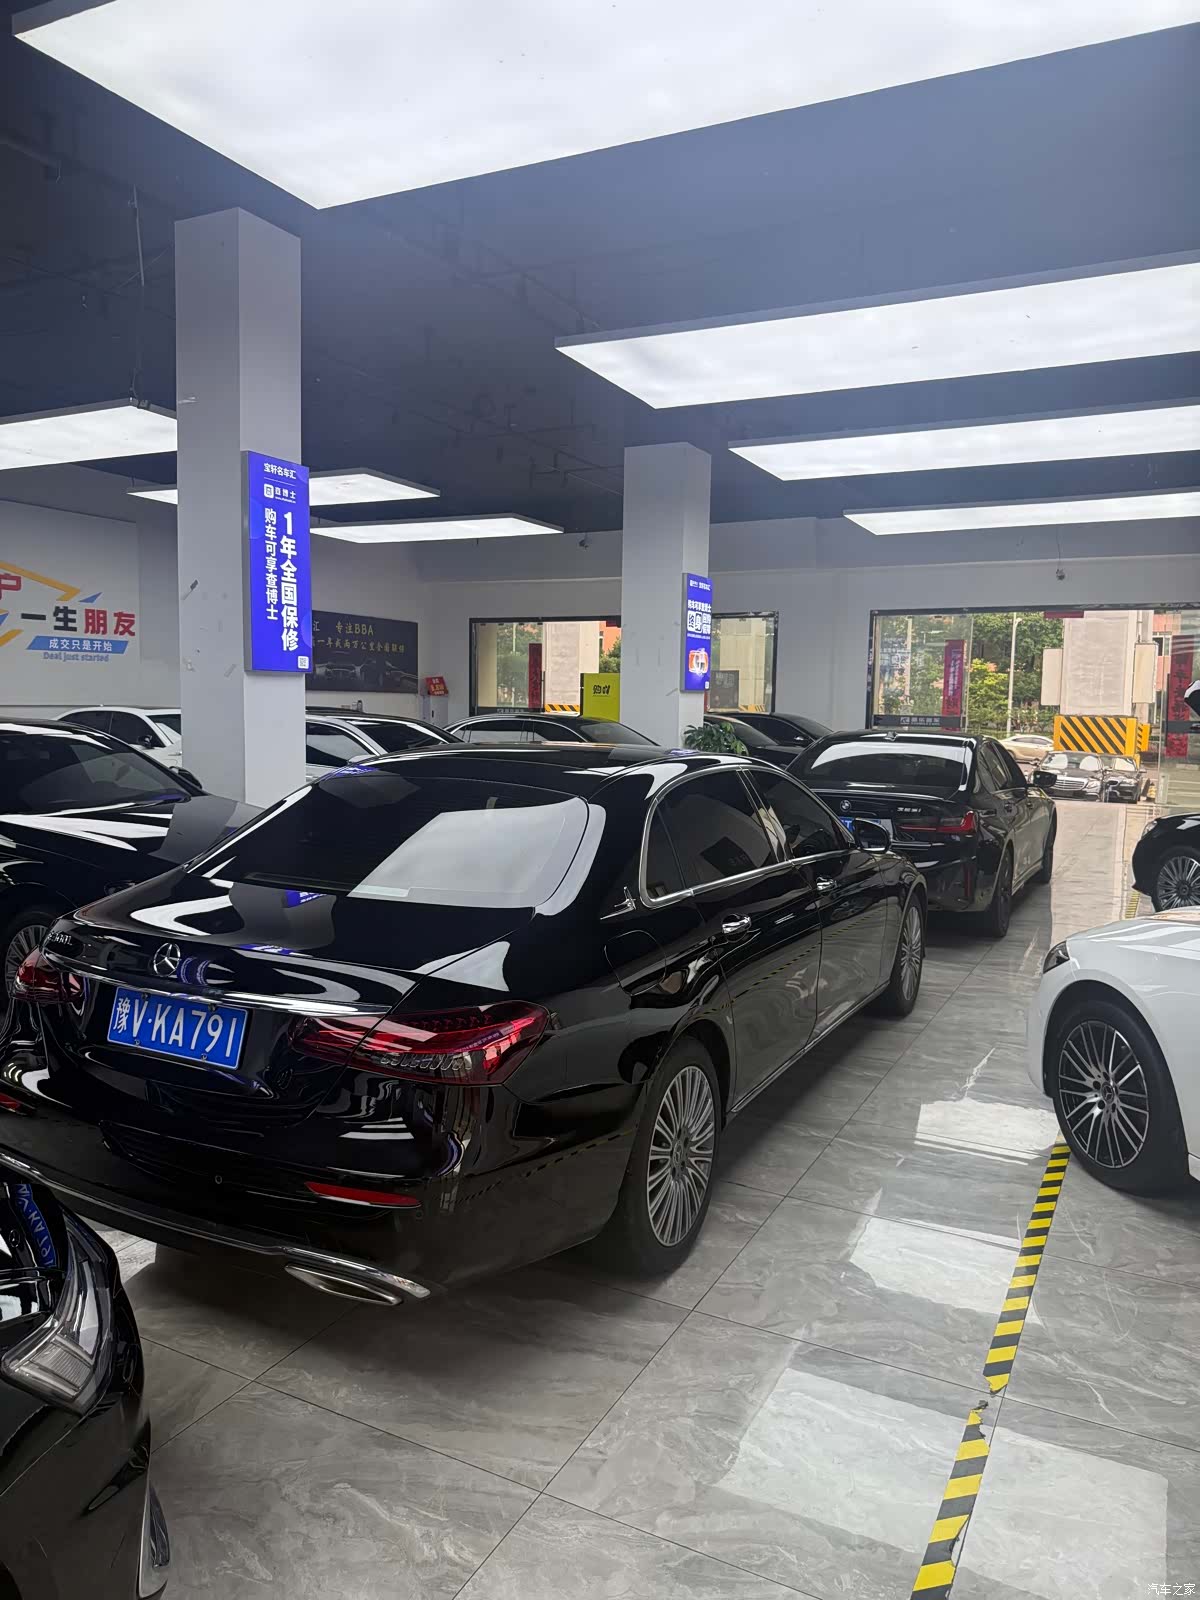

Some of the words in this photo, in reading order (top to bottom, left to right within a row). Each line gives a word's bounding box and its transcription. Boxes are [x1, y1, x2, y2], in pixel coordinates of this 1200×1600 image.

[263, 462, 297, 480] 宝轩名车汇
[264, 507, 278, 621] 购车可享查博士
[280, 511, 299, 652] 1年全国保修
[21, 605, 136, 637] 一生朋友
[43, 651, 61, 660] Deal
[63, 652, 79, 662] just
[81, 653, 109, 662] started
[48, 638, 113, 653] 成交只是开始
